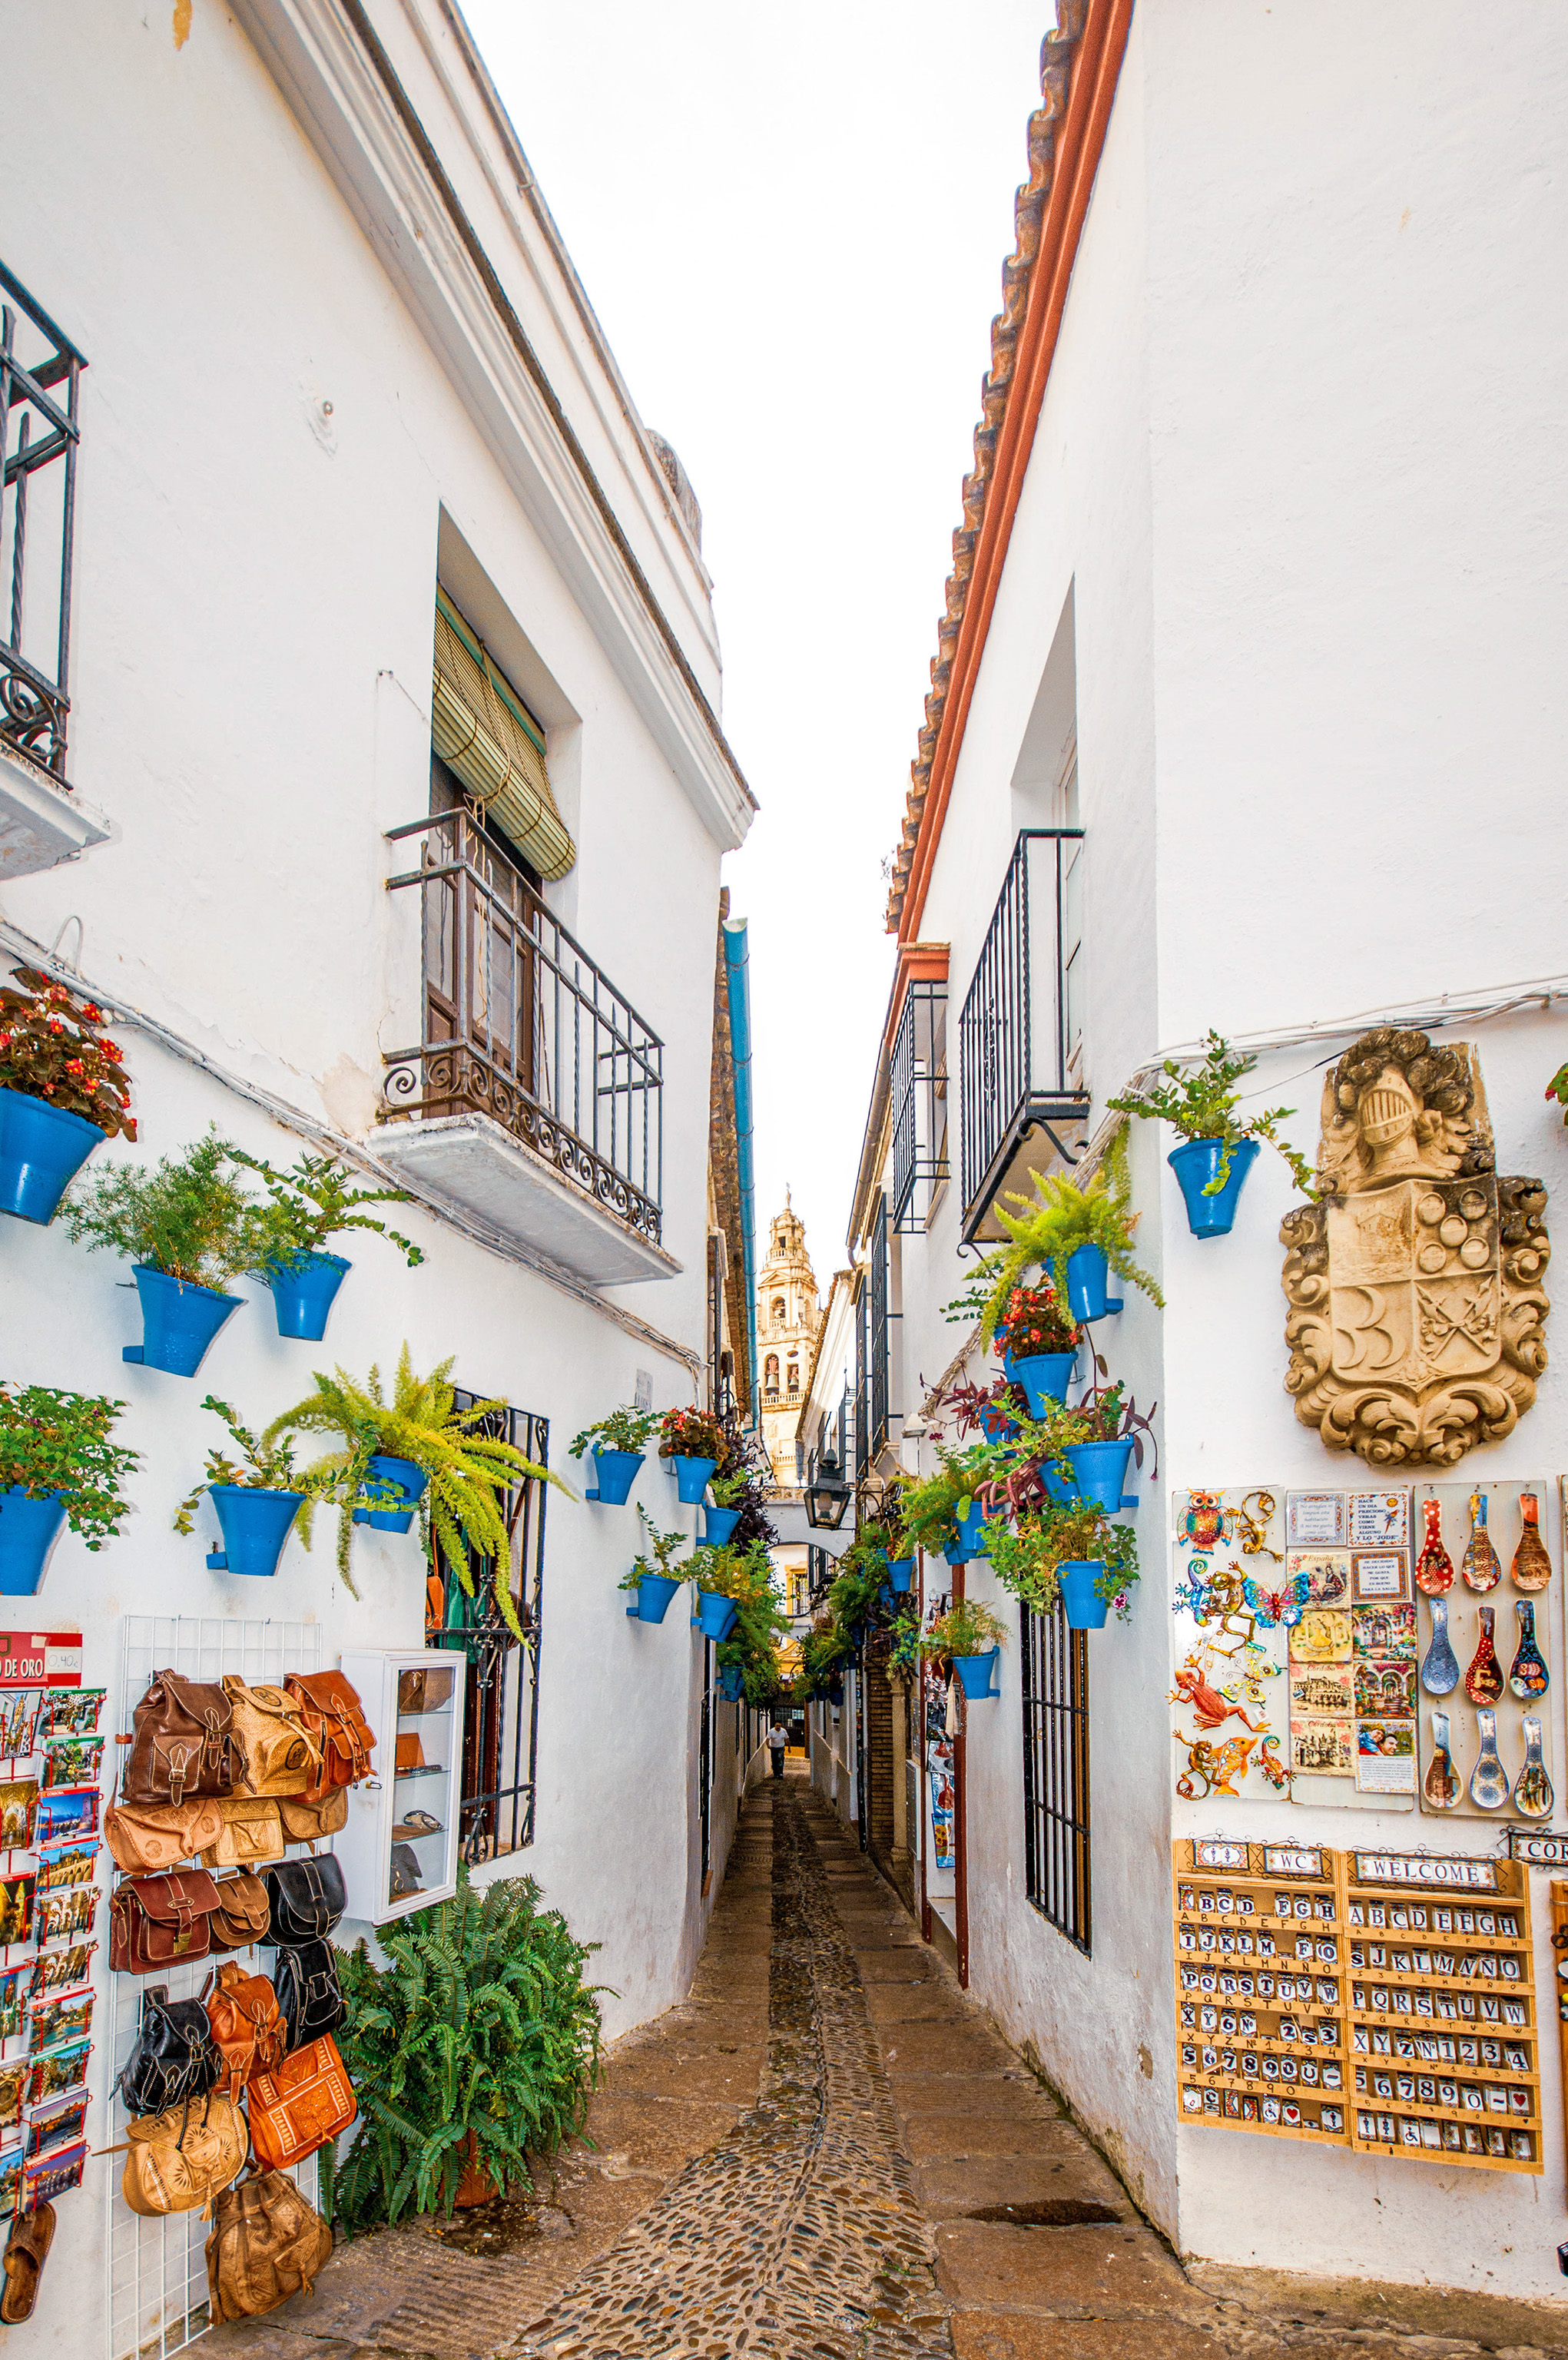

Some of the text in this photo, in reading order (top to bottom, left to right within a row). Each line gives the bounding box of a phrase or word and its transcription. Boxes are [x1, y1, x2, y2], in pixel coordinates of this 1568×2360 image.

[5, 1659, 17, 1678] DE
[21, 1659, 44, 1678] ORO
[1281, 1855, 1307, 1869] WC
[1374, 1861, 1480, 1882] WELCOME
[1202, 1898, 1333, 1917] B C D F G H
[1202, 1914, 1208, 1922] B
[1222, 1915, 1228, 1924] C
[1240, 1917, 1246, 1925] D
[1281, 1920, 1288, 1928] F
[1301, 1921, 1307, 1930] G
[1323, 1923, 1330, 1931] H
[1351, 1908, 1516, 1934] A B C D E F G H
[1185, 1936, 1192, 1946] I
[1203, 1935, 1212, 1946] J
[1222, 1938, 1232, 1949] K
[1240, 1938, 1251, 1950] L
[1261, 1941, 1271, 1953] M
[1225, 1956, 1231, 1964] K
[1281, 1961, 1288, 1970] N
[1351, 1954, 1363, 1964] S
[1373, 1949, 1383, 1964] J
[1393, 1956, 1407, 1969] K
[1415, 1955, 1429, 1970] L
[1438, 1956, 1454, 1972] M
[1460, 1958, 1477, 1974] N
[1186, 1974, 1334, 2000] P Q R S T U V W
[1204, 1994, 1212, 2003] Q
[1225, 1996, 1233, 2005] R
[1244, 1998, 1251, 2007] S
[1263, 2000, 1271, 2009] T
[1285, 2003, 1291, 2011] U
[1304, 2004, 1311, 2014] V
[1353, 1992, 1520, 2022] P Q R S T U V W
[1183, 2010, 1193, 2022] X
[1204, 2014, 1213, 2025] Y
[1223, 2018, 1233, 2030] 6
[1283, 2026, 1295, 2037] 2
[1322, 2030, 1334, 2040] 3
[1354, 2034, 1367, 2050] X
[1375, 2035, 1387, 2050] Y
[1399, 2043, 1412, 2055] Z
[1442, 2043, 1453, 2057] 1
[1462, 2043, 1474, 2059] 2
[1485, 2044, 1497, 2060] 3
[1513, 2053, 1526, 2068] 4
[1185, 2050, 1195, 2061] 5
[1205, 2052, 1215, 2064] 6
[1224, 2055, 1235, 2067] 7
[1245, 2057, 1255, 2070] 8
[1265, 2062, 1277, 2074] 9
[1377, 2080, 1390, 2093] 6
[1401, 2082, 1412, 2096] 7
[1420, 2081, 1434, 2096] 8
[1443, 2086, 1455, 2101] 9
